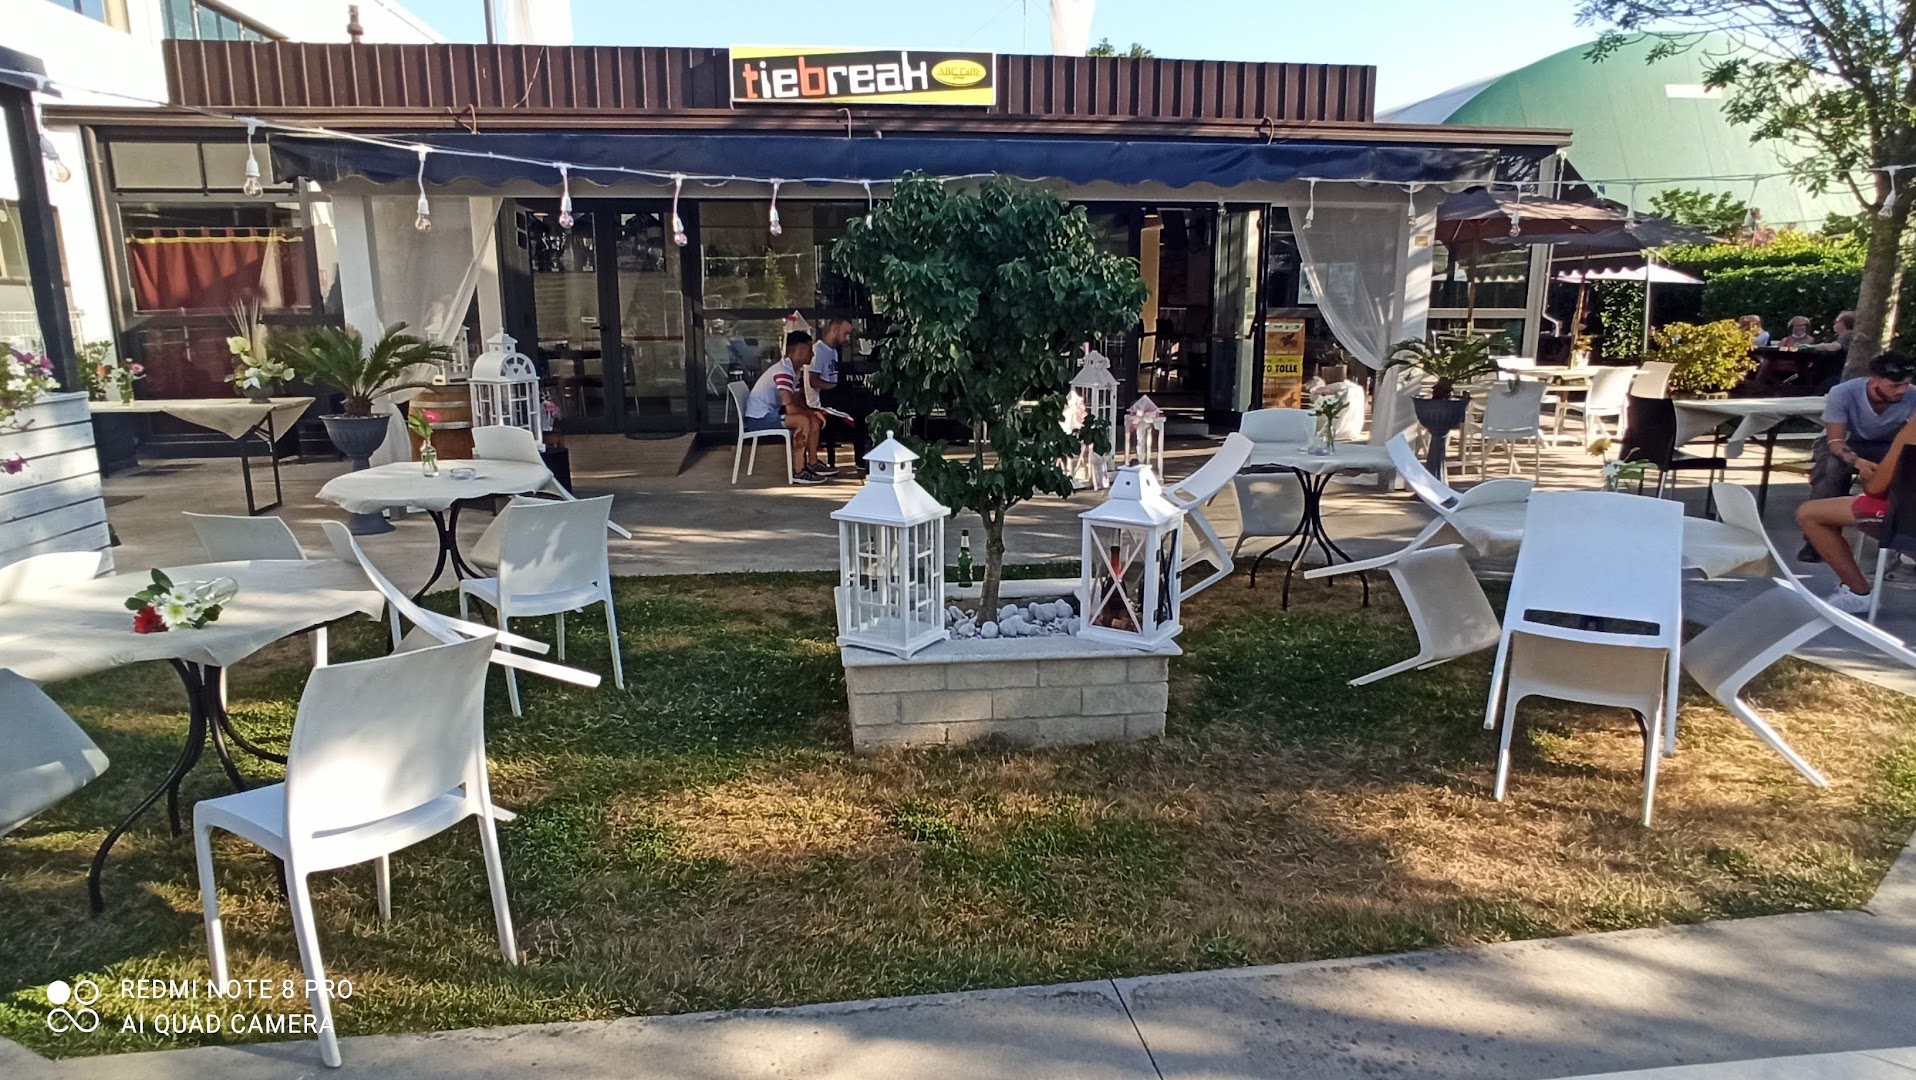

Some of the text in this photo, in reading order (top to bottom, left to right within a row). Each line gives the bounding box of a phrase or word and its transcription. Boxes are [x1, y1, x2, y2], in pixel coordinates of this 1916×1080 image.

[742, 51, 928, 99] tiebreak
[938, 67, 958, 76] ABC
[1275, 364, 1297, 373] TOLLE
